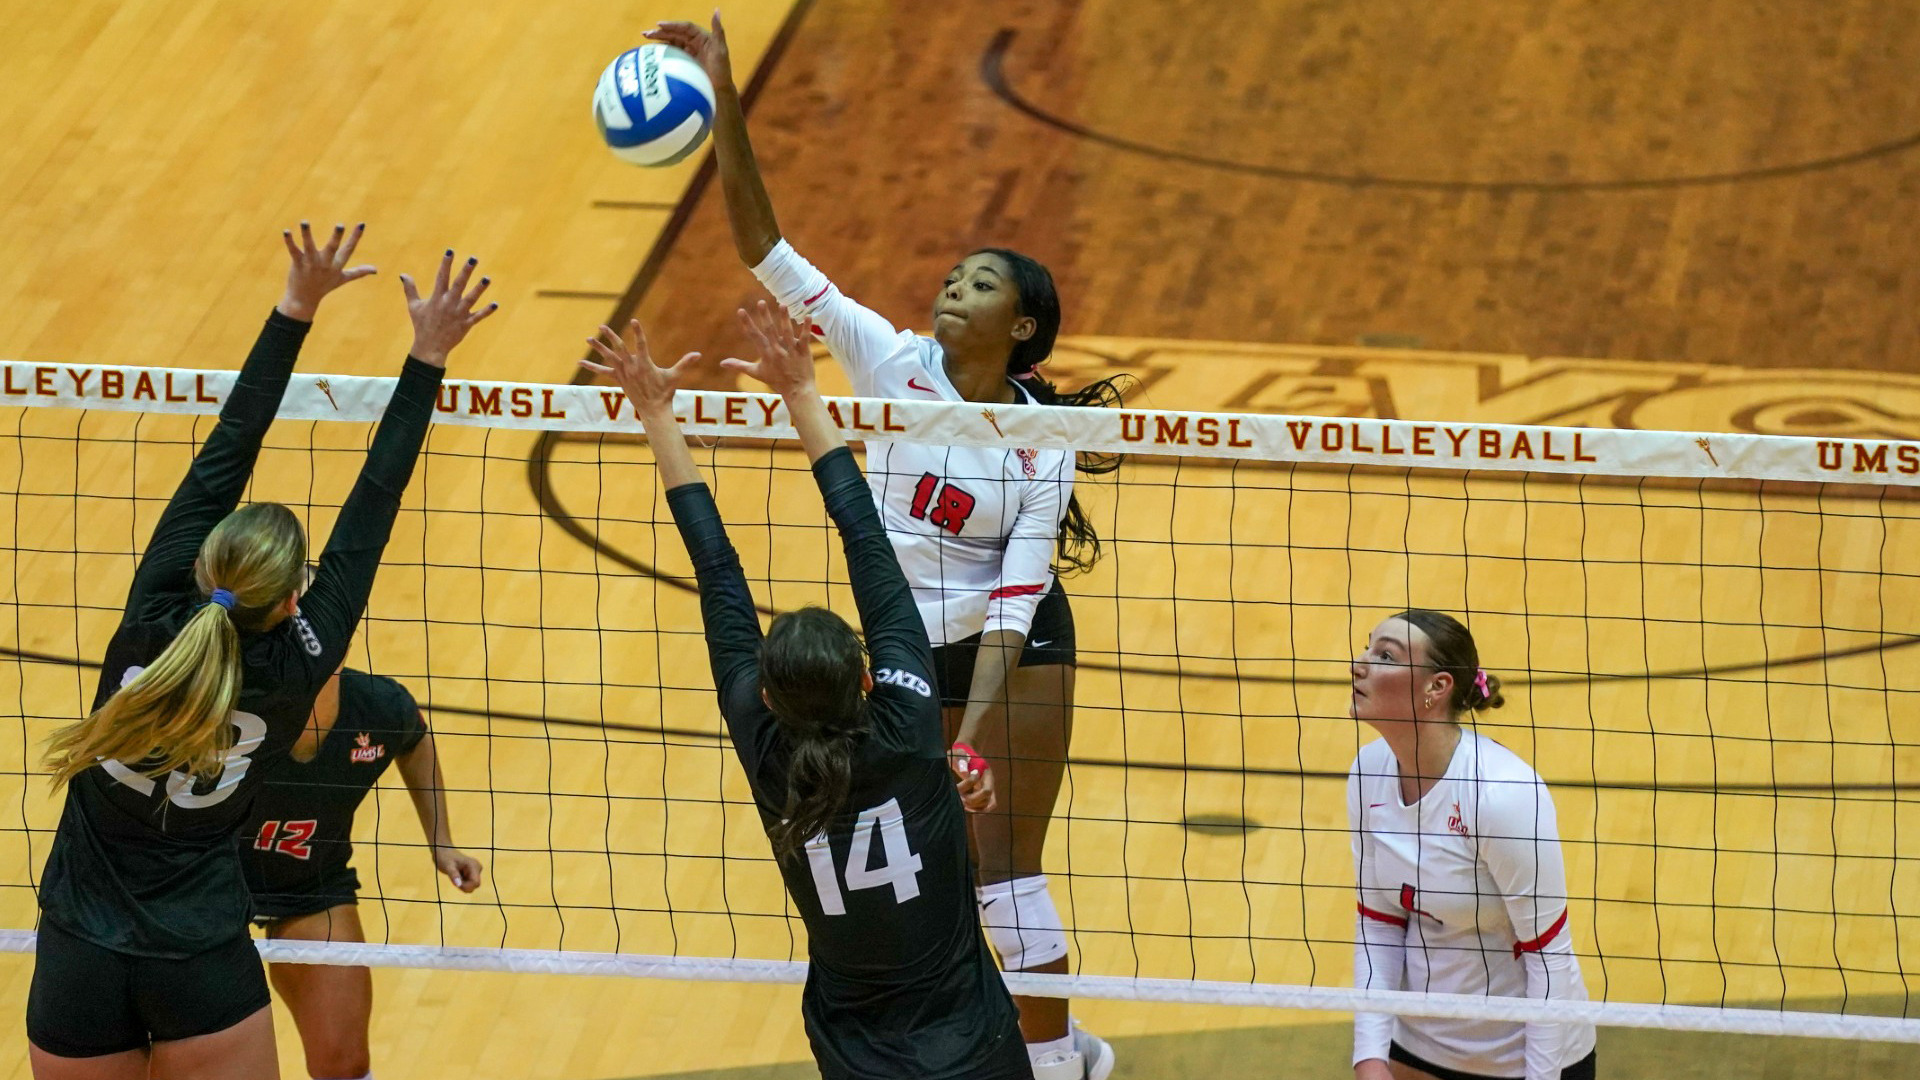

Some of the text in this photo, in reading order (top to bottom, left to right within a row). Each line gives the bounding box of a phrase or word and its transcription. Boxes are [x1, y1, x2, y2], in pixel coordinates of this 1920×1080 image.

[4, 366, 218, 403] LEYBALL
[436, 384, 906, 432] UMSL VLEYALL
[1120, 414, 1597, 463] UMSL VOLLEYBALL
[1817, 441, 1920, 474] UMS
[910, 471, 976, 536] 18
[876, 667, 931, 698] GLVC
[351, 745, 385, 762] UMSL
[254, 820, 317, 860] 12
[803, 797, 923, 915] 14
